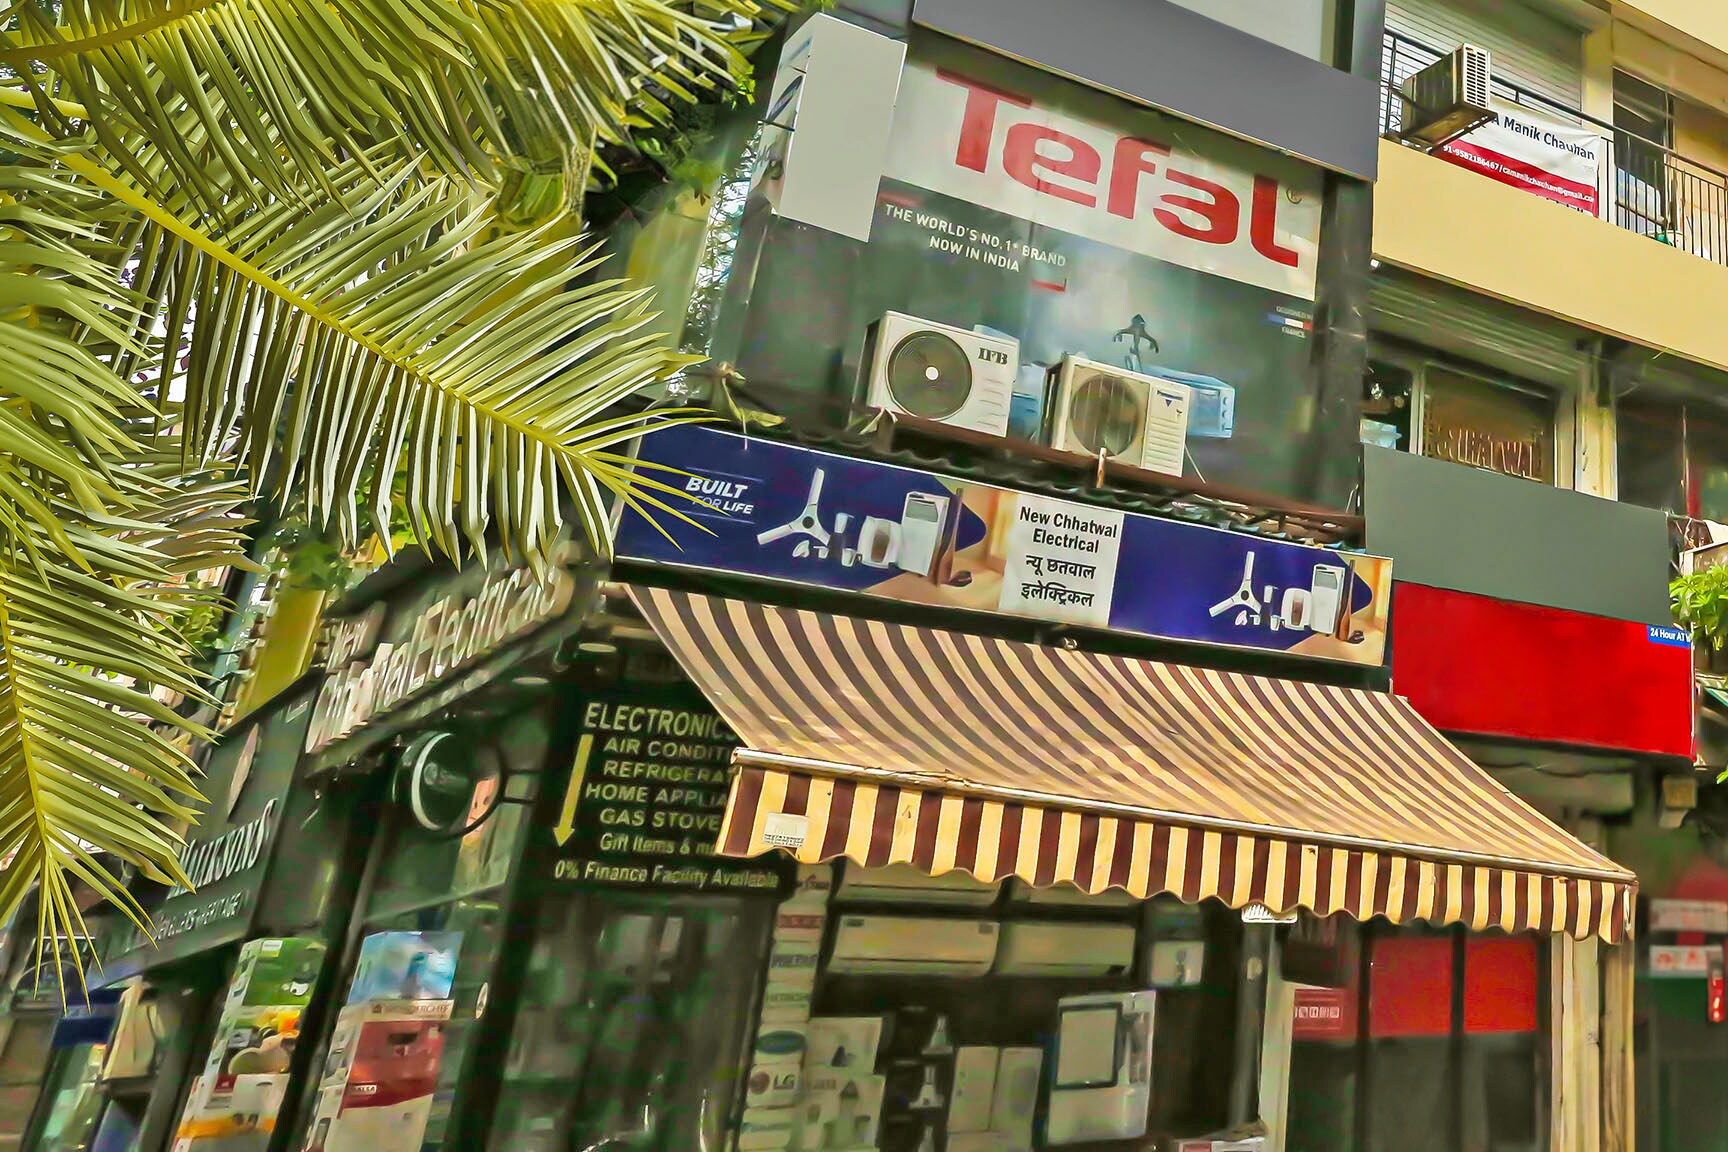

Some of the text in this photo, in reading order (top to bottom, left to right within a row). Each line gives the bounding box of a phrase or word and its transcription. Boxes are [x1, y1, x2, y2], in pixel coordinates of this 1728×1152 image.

[1504, 116, 1540, 142] Manik
[1543, 132, 1596, 161] Chauhan
[935, 65, 1299, 268] Tefal
[886, 203, 914, 223] THE
[916, 213, 978, 241] WORLD'S
[1022, 244, 1067, 267] BRAND
[929, 236, 1020, 273] NOW IN INDIA
[978, 347, 1008, 365] IFB
[685, 476, 749, 499] BUILT
[722, 501, 754, 515] LIFE
[1019, 506, 1118, 538] New Chhatwal
[1032, 527, 1100, 554] Electrical
[1025, 554, 1097, 580] न्यू छतवाल
[603, 736, 642, 756] AIR
[585, 782, 649, 803] HOME
[600, 806, 645, 827] GAS
[584, 861, 649, 883] Finance
